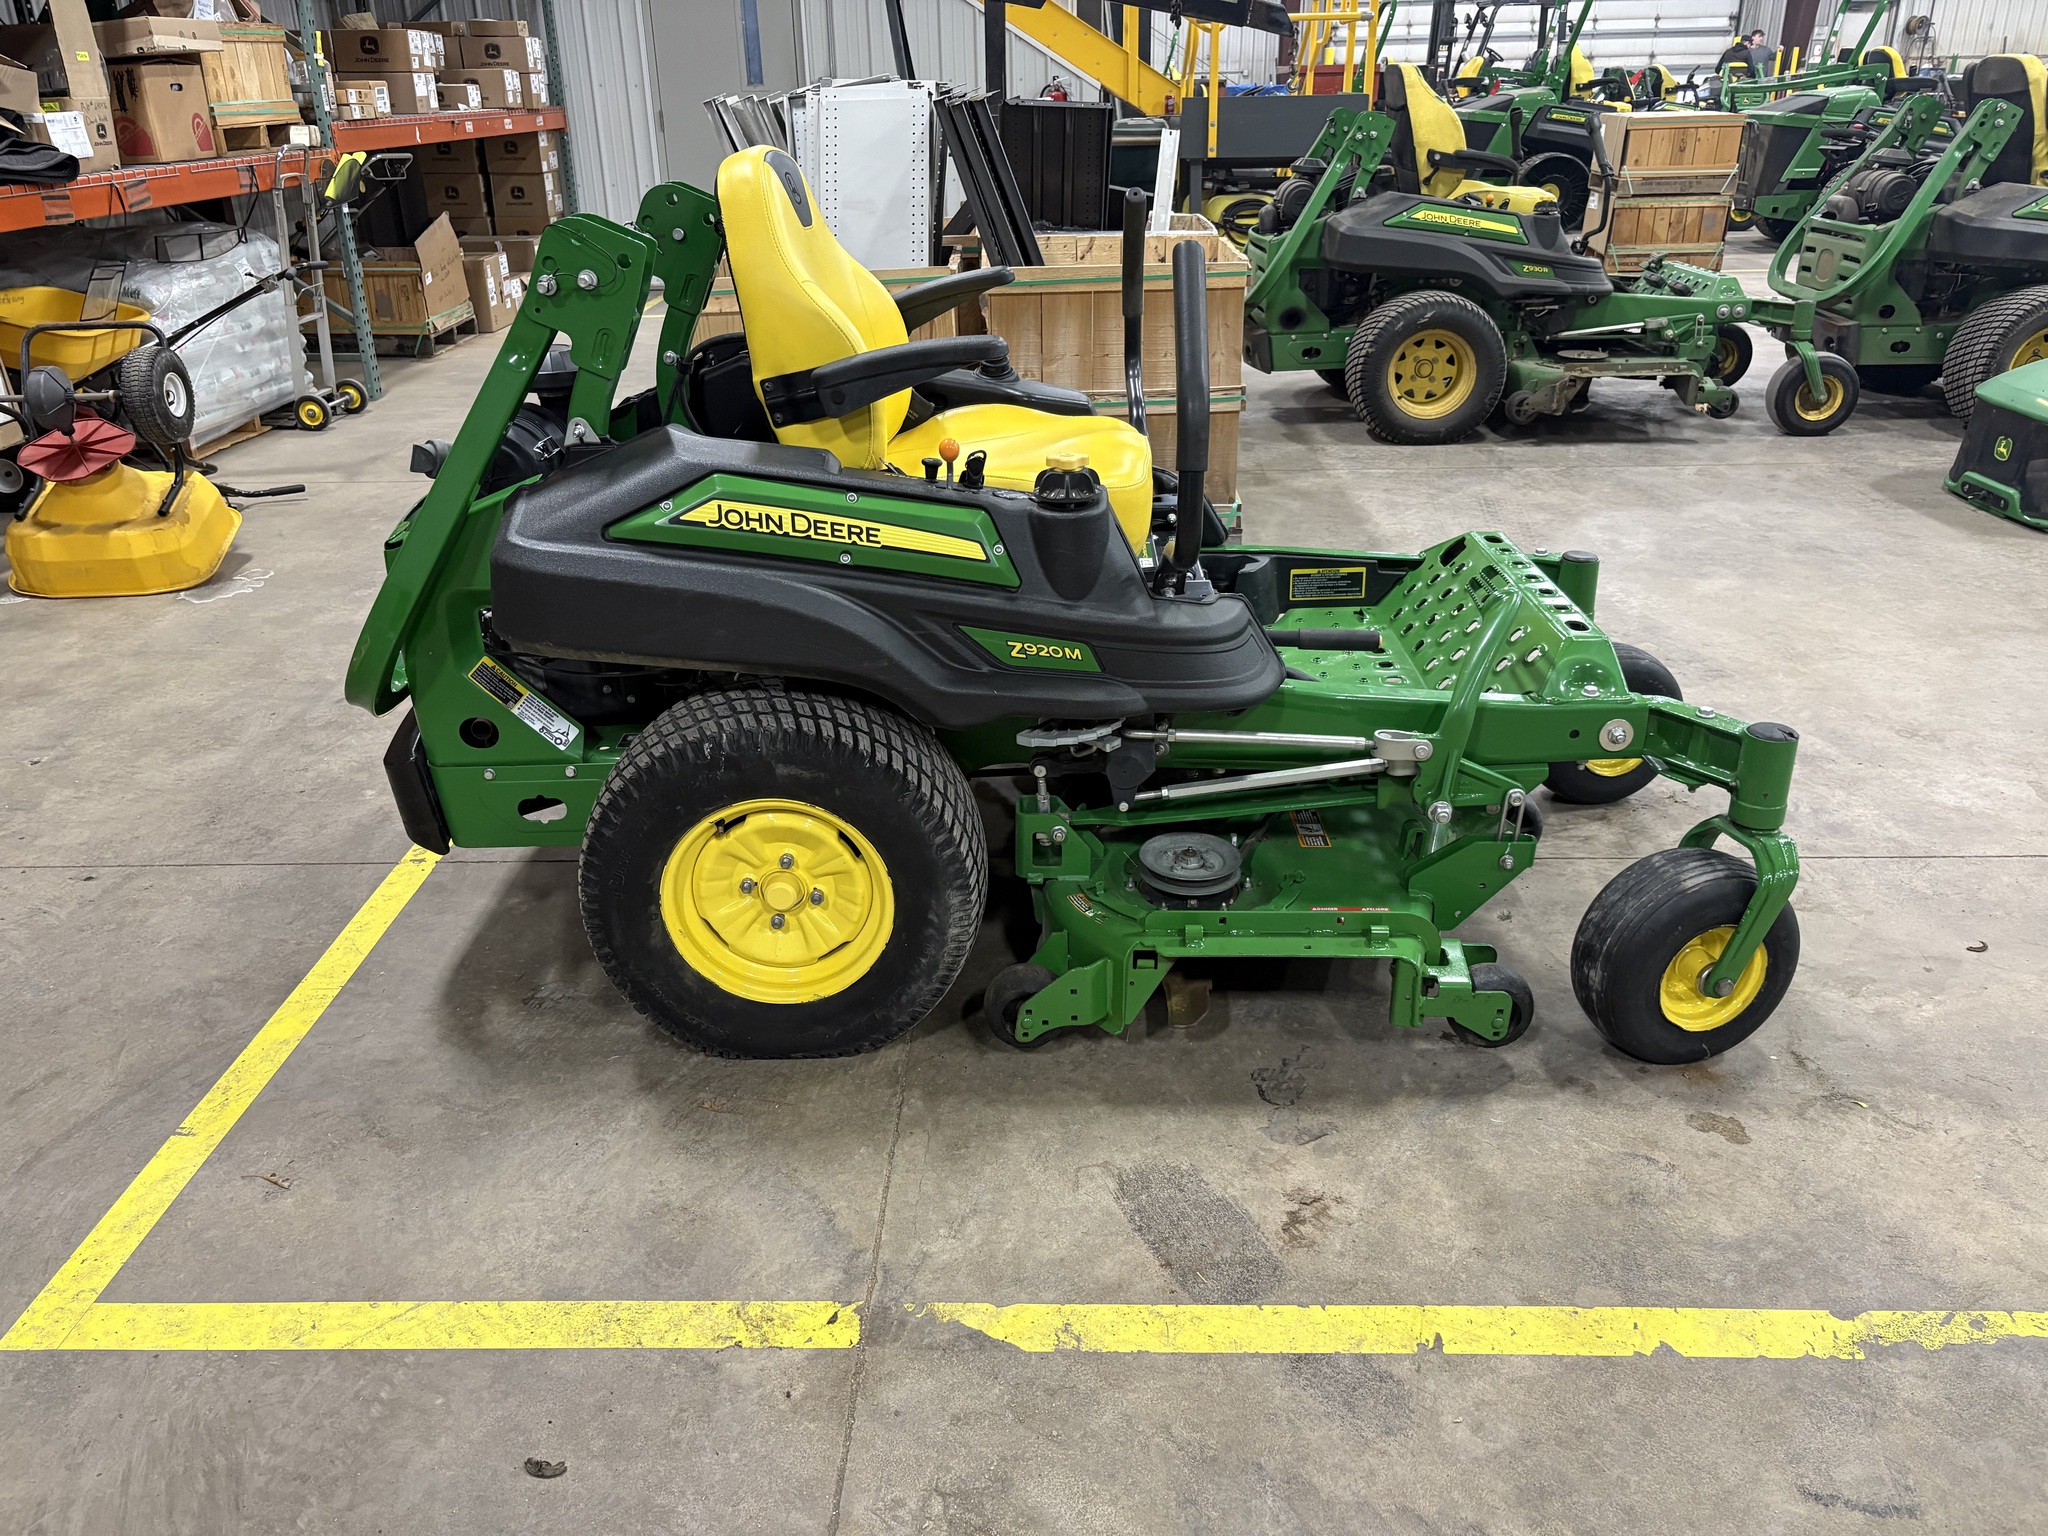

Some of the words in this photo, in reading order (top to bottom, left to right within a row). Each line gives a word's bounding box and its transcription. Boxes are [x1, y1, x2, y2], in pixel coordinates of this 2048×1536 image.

[1421, 212, 1448, 222] JOHN
[1449, 215, 1481, 228] DEERE
[1522, 264, 1549, 273] Z930R
[707, 504, 784, 532] JOHN
[790, 513, 882, 544] DEERE
[1007, 641, 1083, 660] Z920M
[496, 668, 518, 687] CAUTION
